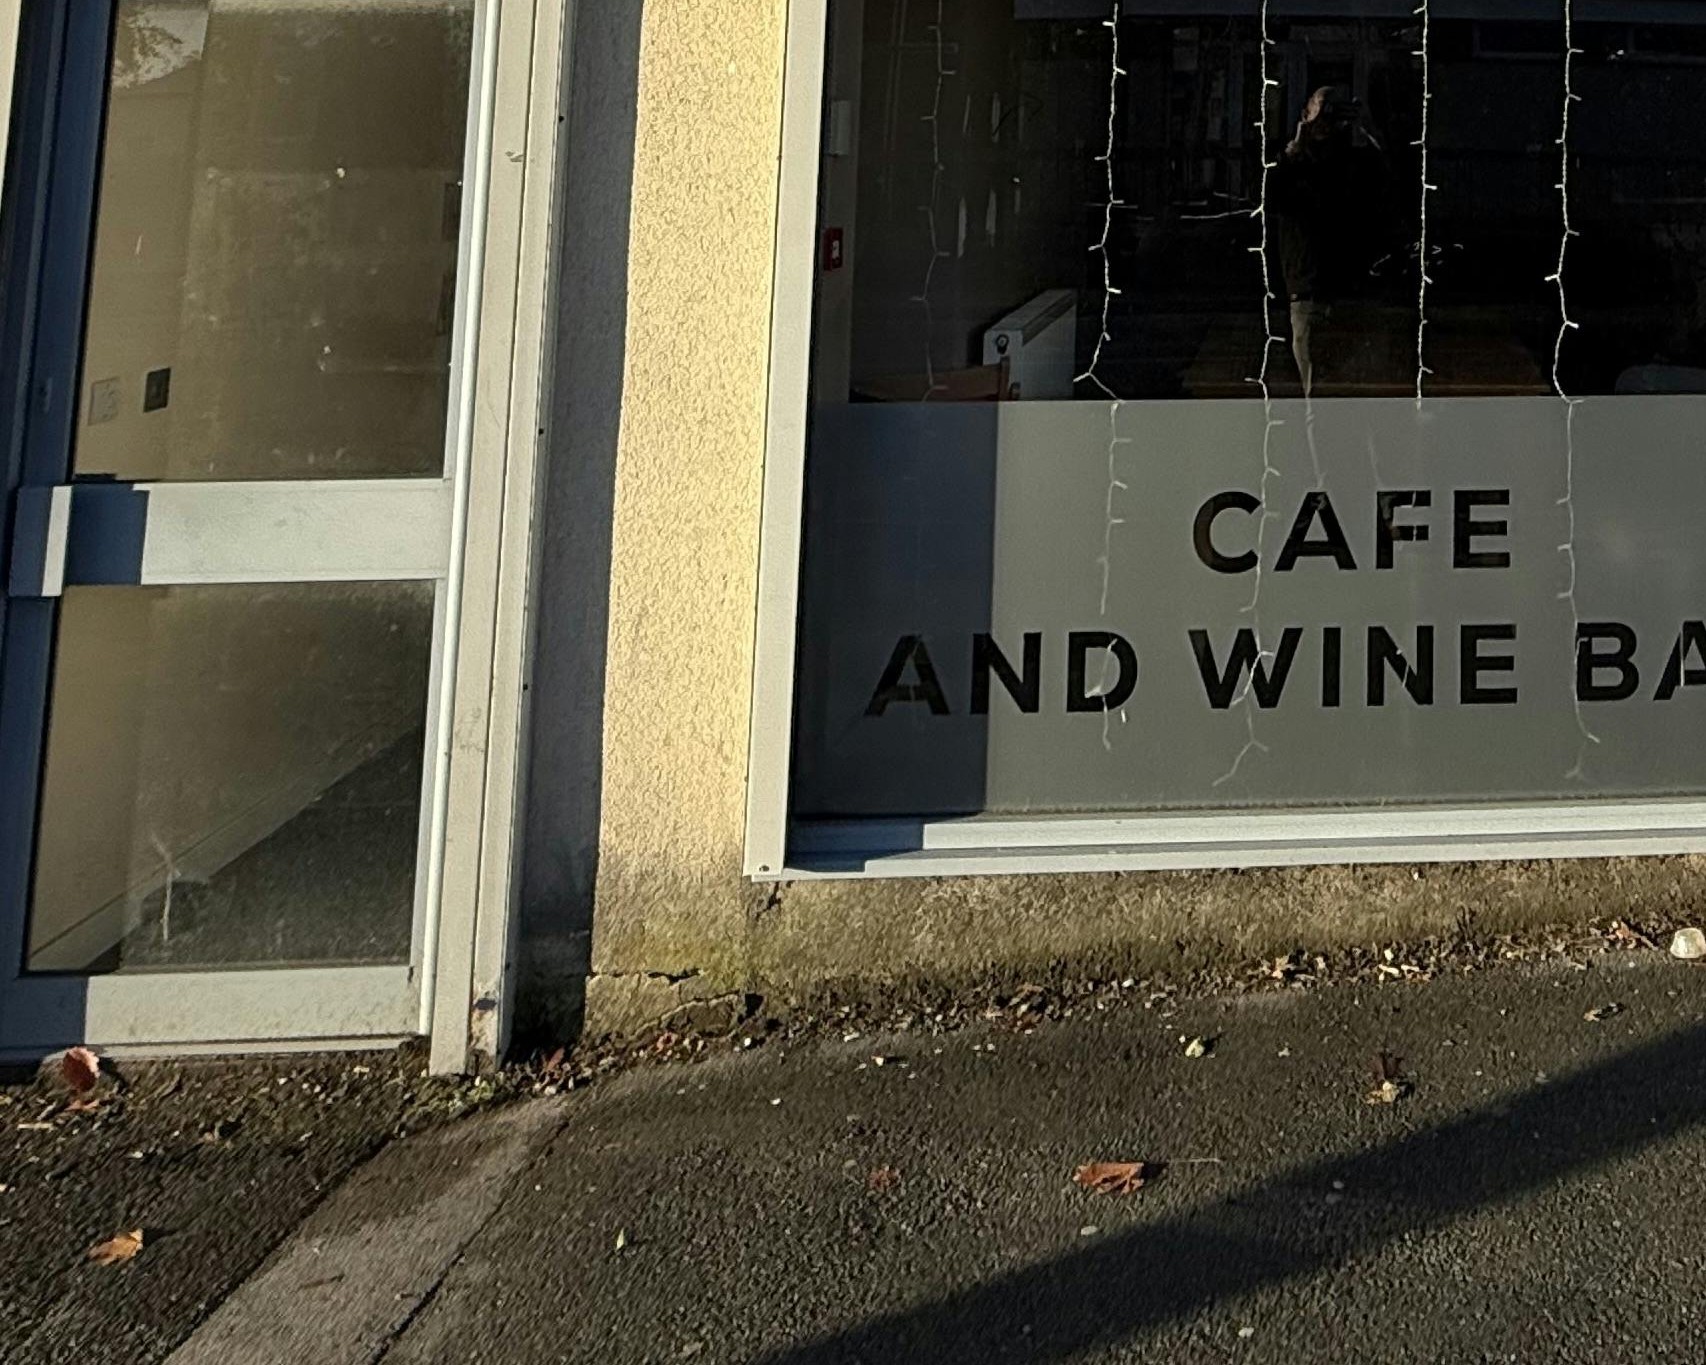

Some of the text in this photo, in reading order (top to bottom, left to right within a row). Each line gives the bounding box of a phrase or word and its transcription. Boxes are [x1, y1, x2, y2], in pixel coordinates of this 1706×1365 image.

[1193, 489, 1511, 574] CAFE
[864, 631, 1140, 717] AND
[1189, 622, 1520, 710] WINE
